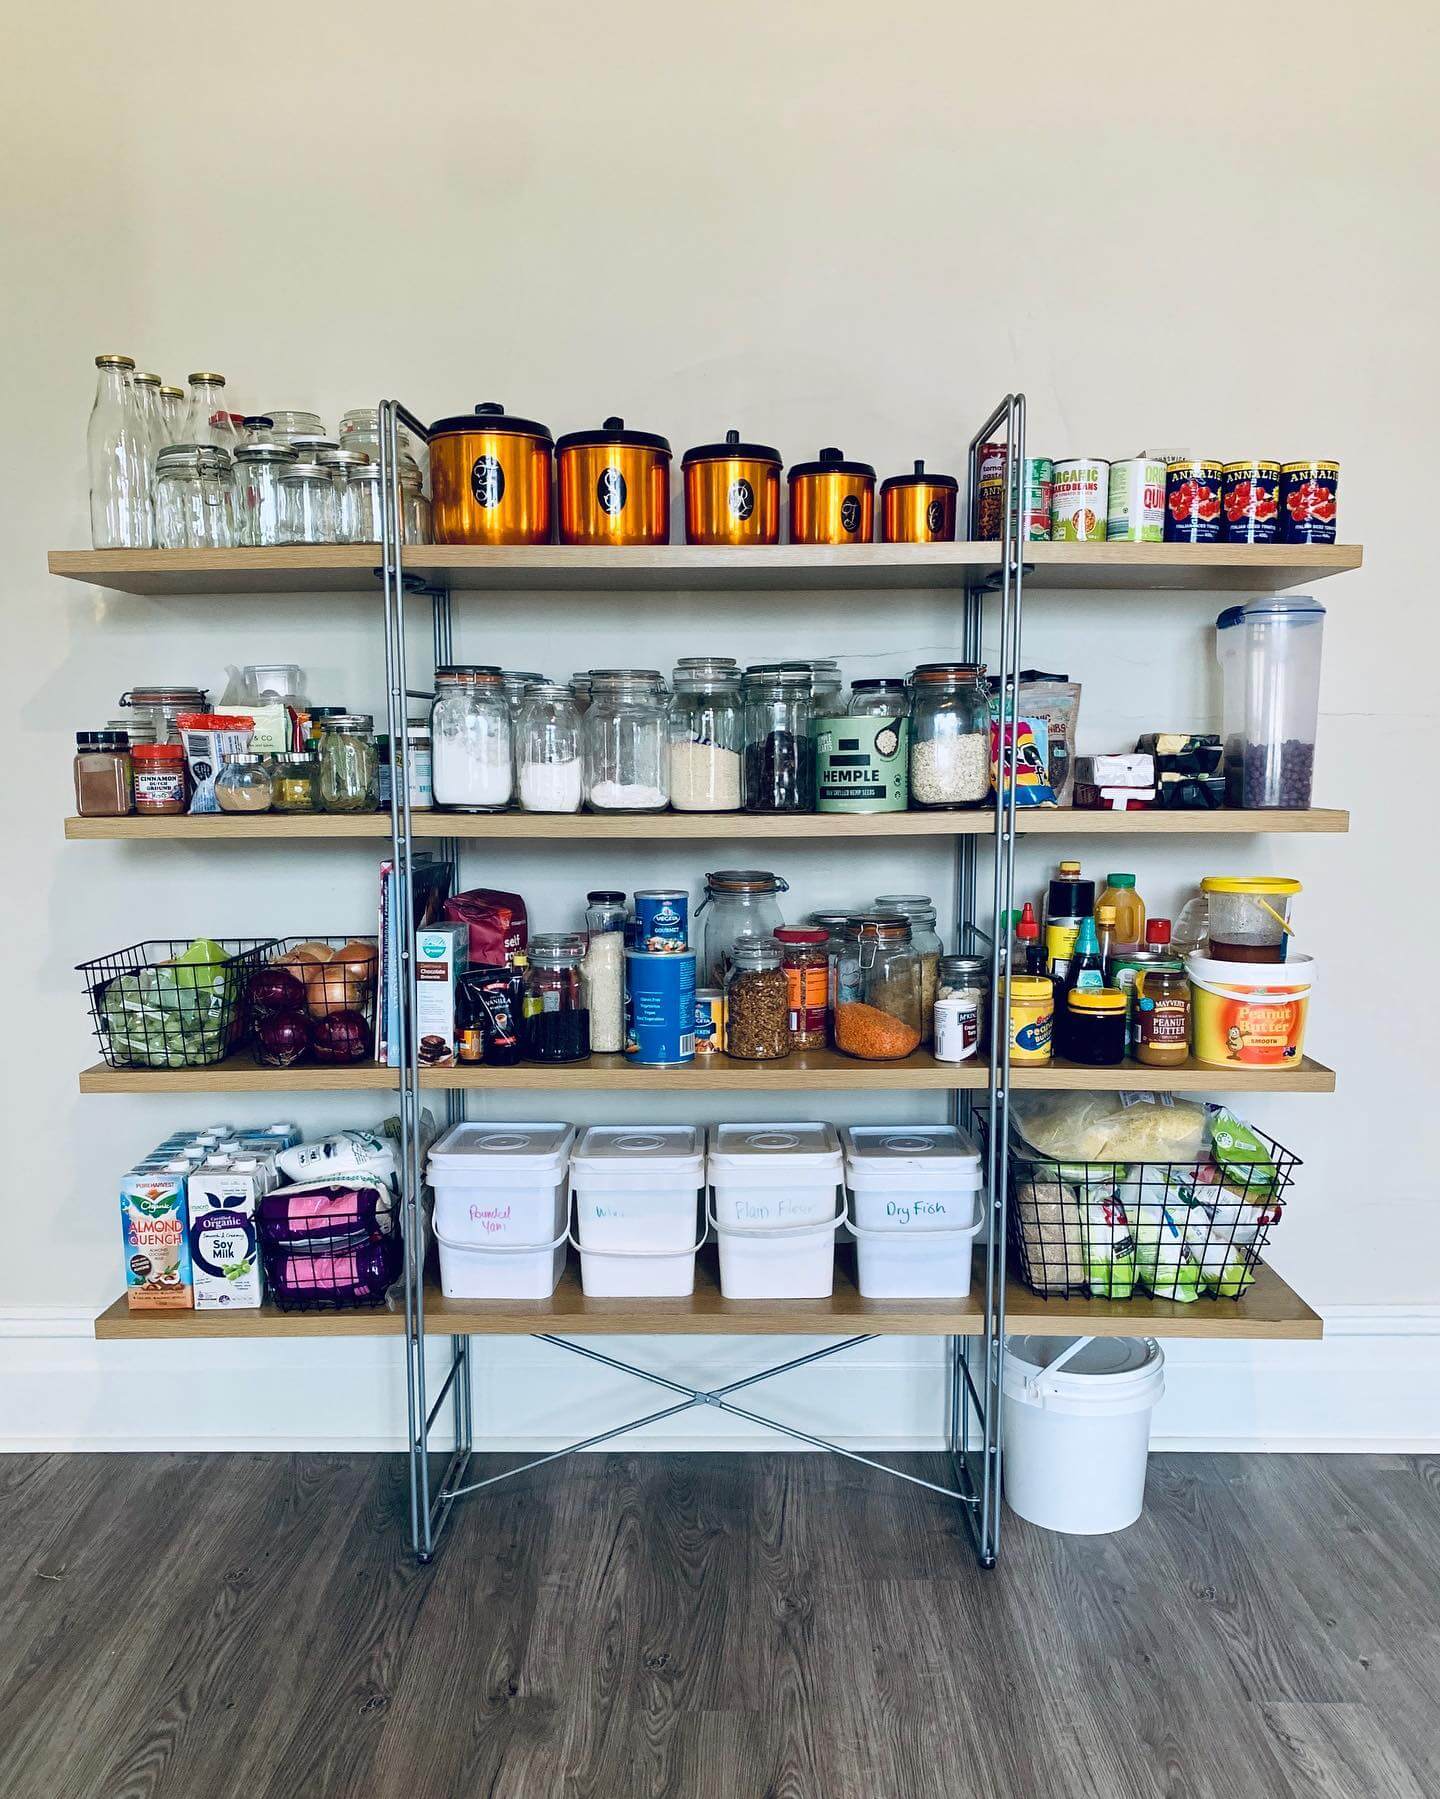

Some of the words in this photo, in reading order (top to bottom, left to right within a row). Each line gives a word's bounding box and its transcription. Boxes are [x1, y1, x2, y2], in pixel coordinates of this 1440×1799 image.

[1056, 469, 1098, 483] RGANIC
[823, 770, 880, 782] HEMPLE
[504, 934, 520, 948] self
[485, 998, 512, 1006] VANILLA
[1238, 1005, 1292, 1020] Peanut
[1153, 1018, 1185, 1026] PEANUT
[1153, 1027, 1185, 1035] BUTTER
[886, 1201, 911, 1224] Dry
[914, 1201, 947, 1217] Fish
[129, 1220, 183, 1233] ALMOND
[203, 1217, 241, 1229] Organic
[129, 1234, 183, 1246] QUENCH
[213, 1239, 233, 1250] Soy
[213, 1249, 235, 1258] Milk
